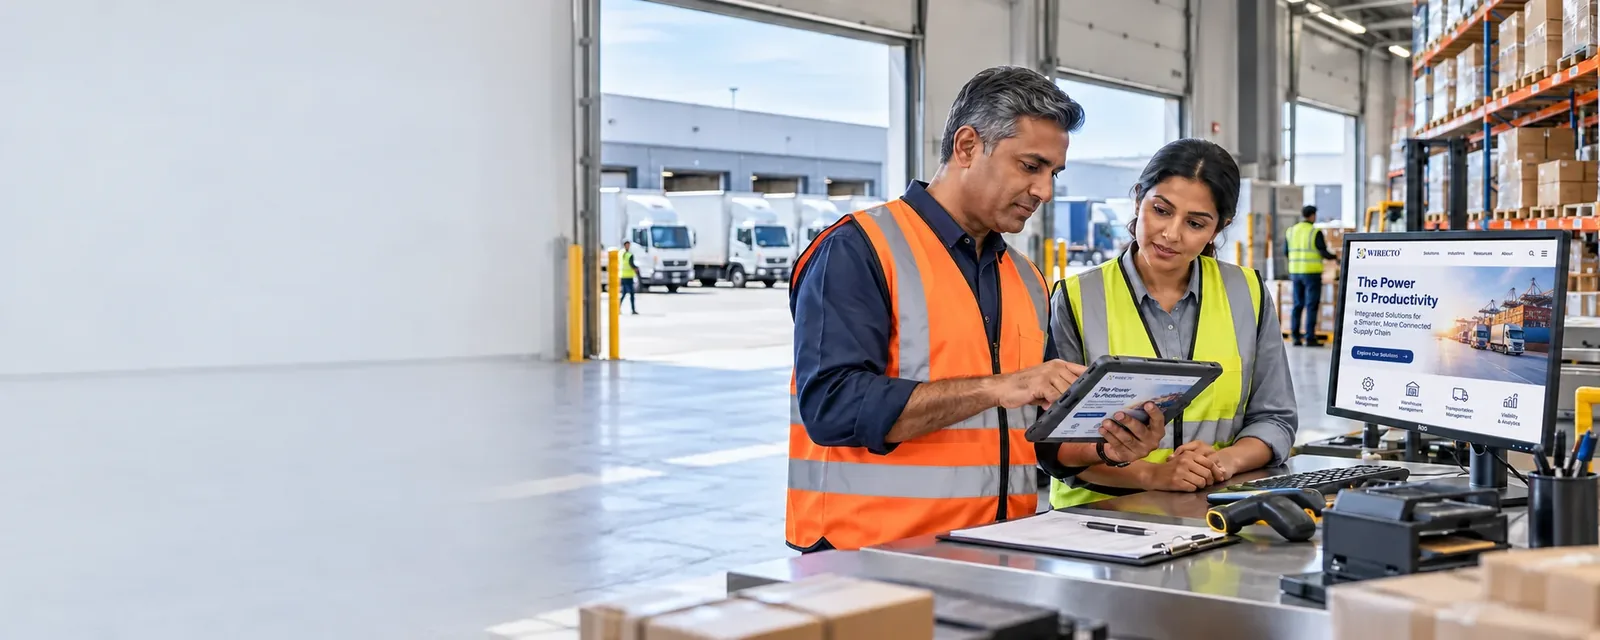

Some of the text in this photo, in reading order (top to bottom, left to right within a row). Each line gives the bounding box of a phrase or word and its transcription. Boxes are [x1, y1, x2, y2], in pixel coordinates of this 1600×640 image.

[1358, 276, 1416, 288] The Power
[1356, 292, 1438, 308] To Productivity
[1354, 310, 1384, 318] Integrated
[1359, 319, 1382, 327] Smarter,
[1353, 328, 1373, 336] Supply
